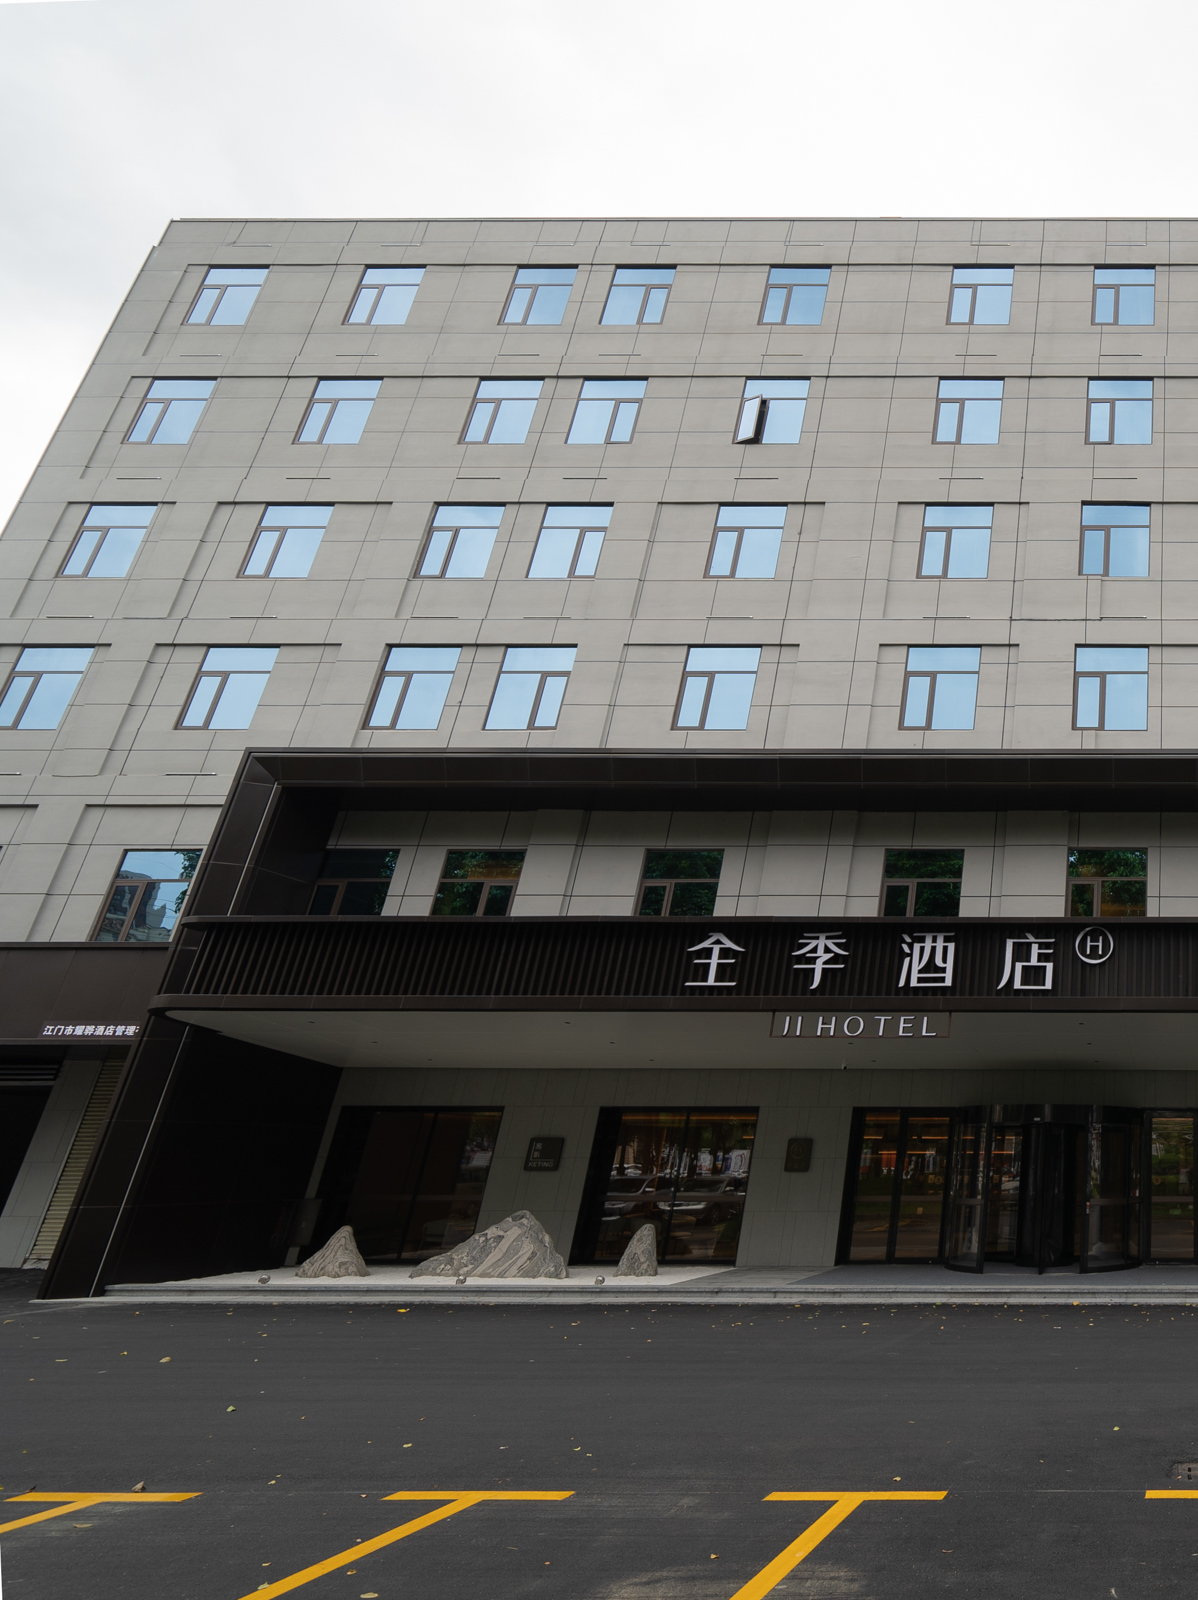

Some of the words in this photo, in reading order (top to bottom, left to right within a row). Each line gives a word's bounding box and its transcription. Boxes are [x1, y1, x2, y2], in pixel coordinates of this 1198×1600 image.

[684, 931, 1055, 990] 全季酒店
[782, 1015, 803, 1037] JI
[816, 1015, 938, 1037] HOTEL
